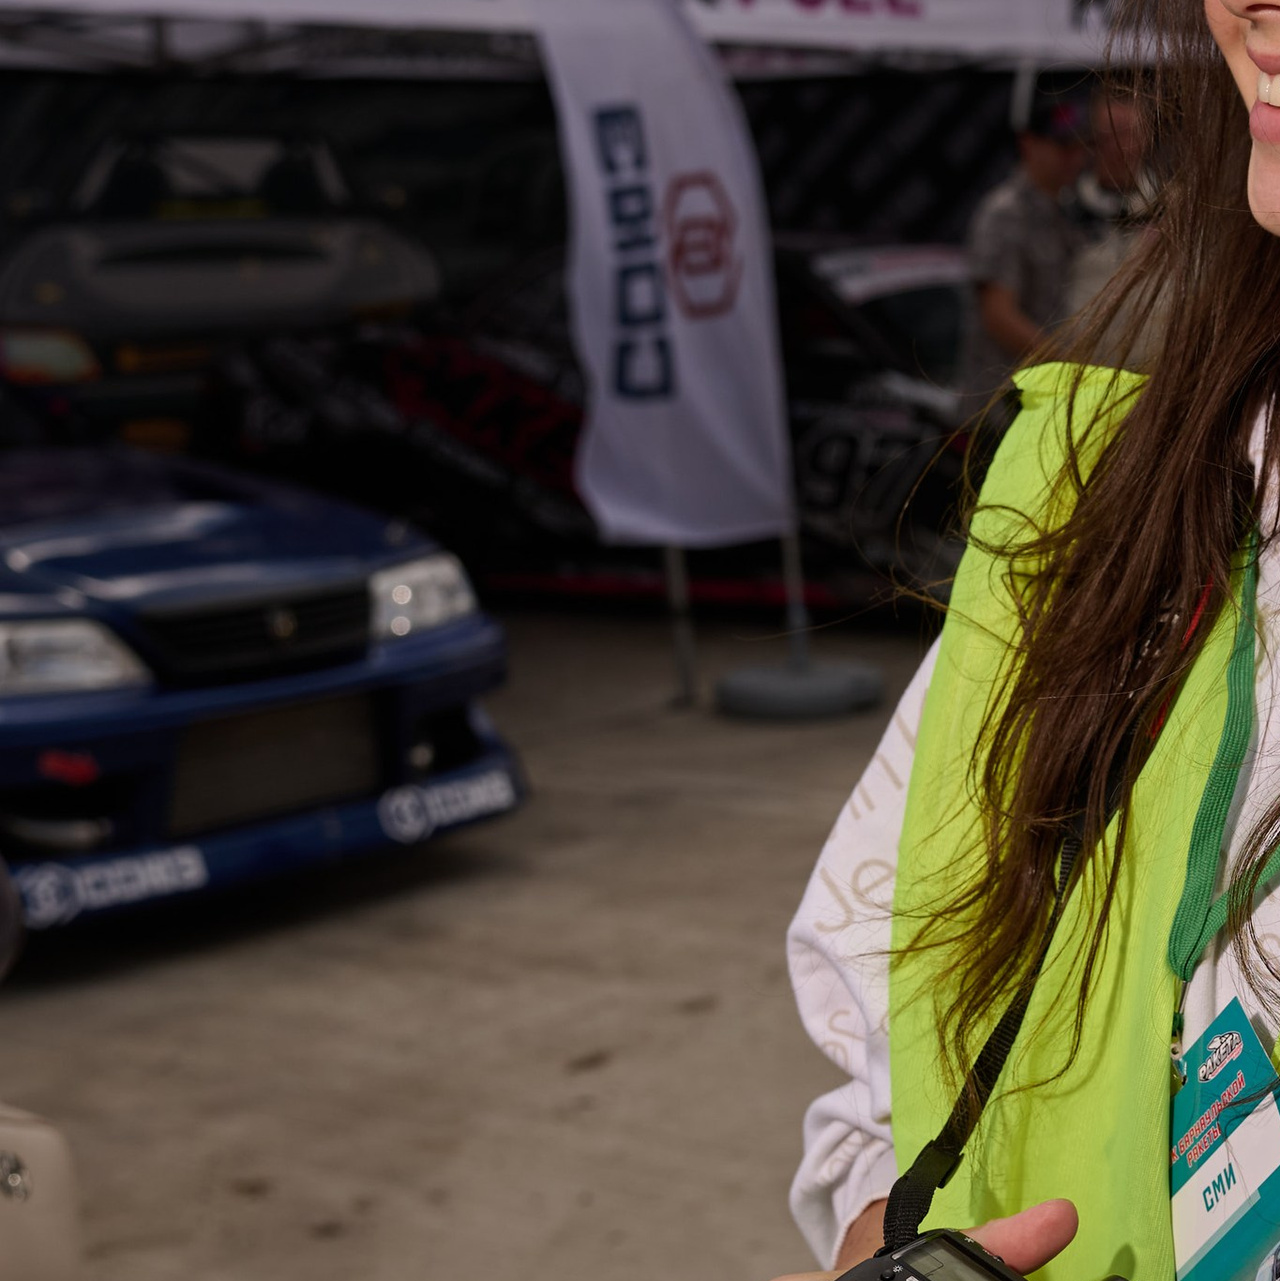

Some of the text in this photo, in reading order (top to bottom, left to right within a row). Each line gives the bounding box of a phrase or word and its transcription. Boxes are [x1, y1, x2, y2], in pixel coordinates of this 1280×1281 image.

[1199, 1033, 1242, 1080] РАКЕТА
[1179, 1070, 1246, 1156] БАРНАУЛЬСКОЙ
[1186, 1122, 1222, 1169] РАКЕТЫ
[1202, 1162, 1237, 1213] СМИ
